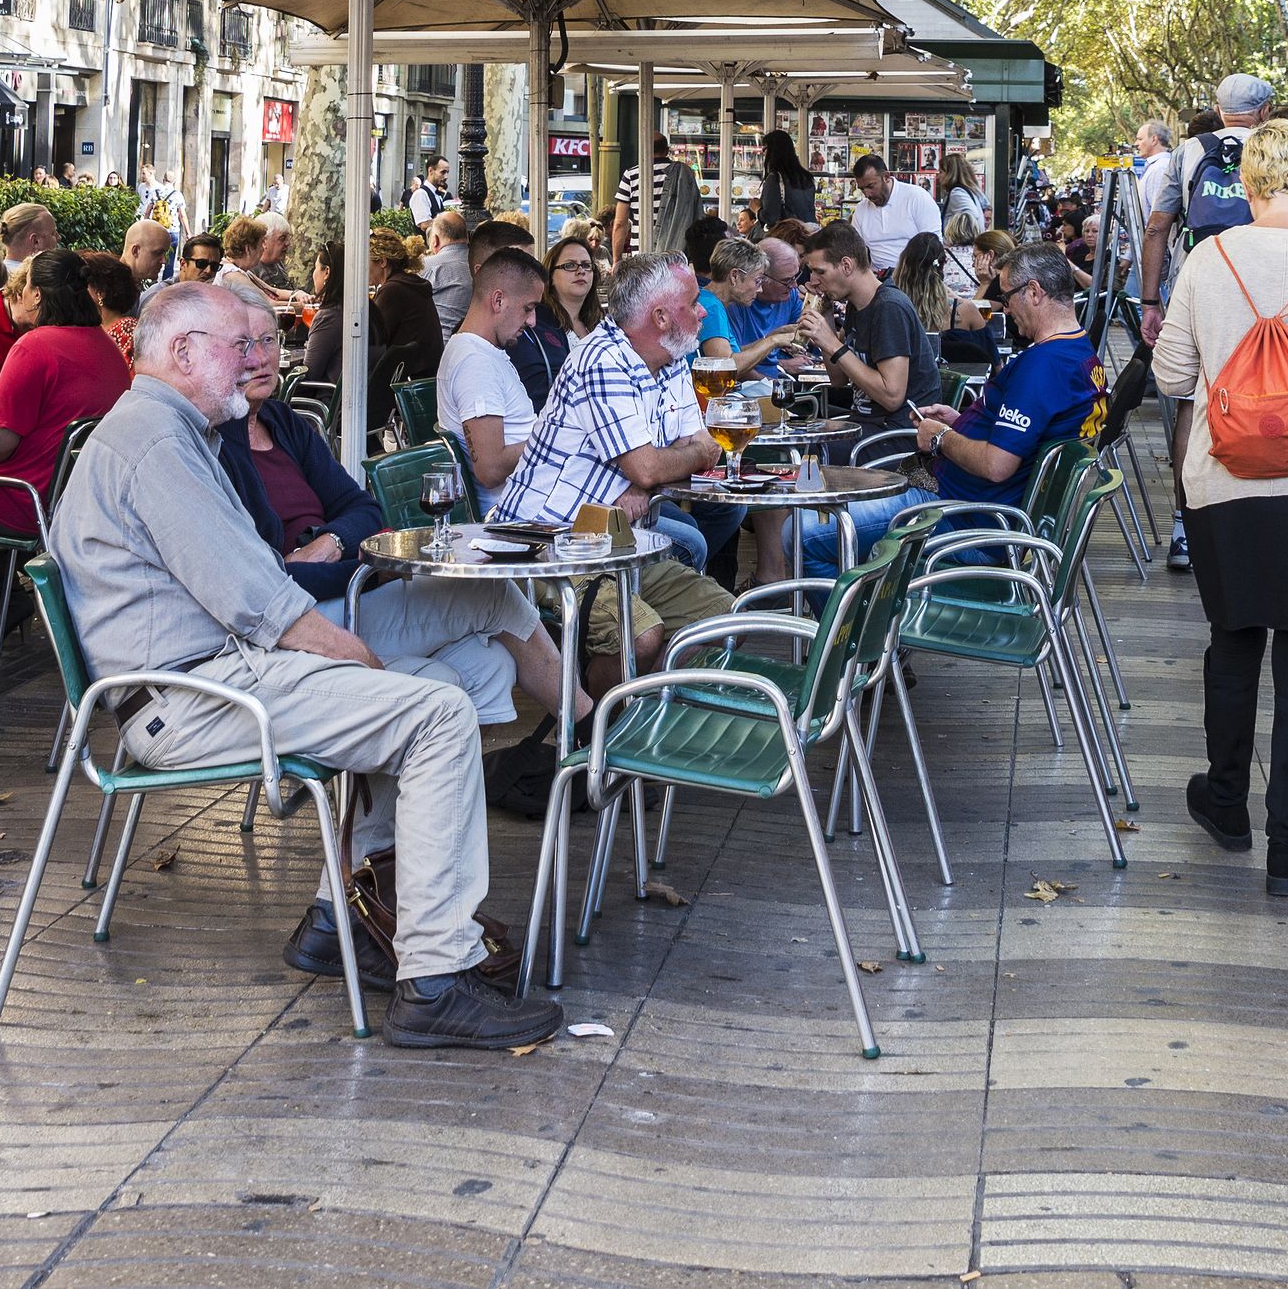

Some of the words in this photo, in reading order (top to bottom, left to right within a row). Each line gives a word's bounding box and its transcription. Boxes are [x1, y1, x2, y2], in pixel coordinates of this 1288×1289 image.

[553, 138, 590, 156] KFC
[1201, 180, 1247, 200] NIKE
[998, 403, 1032, 428] beko
